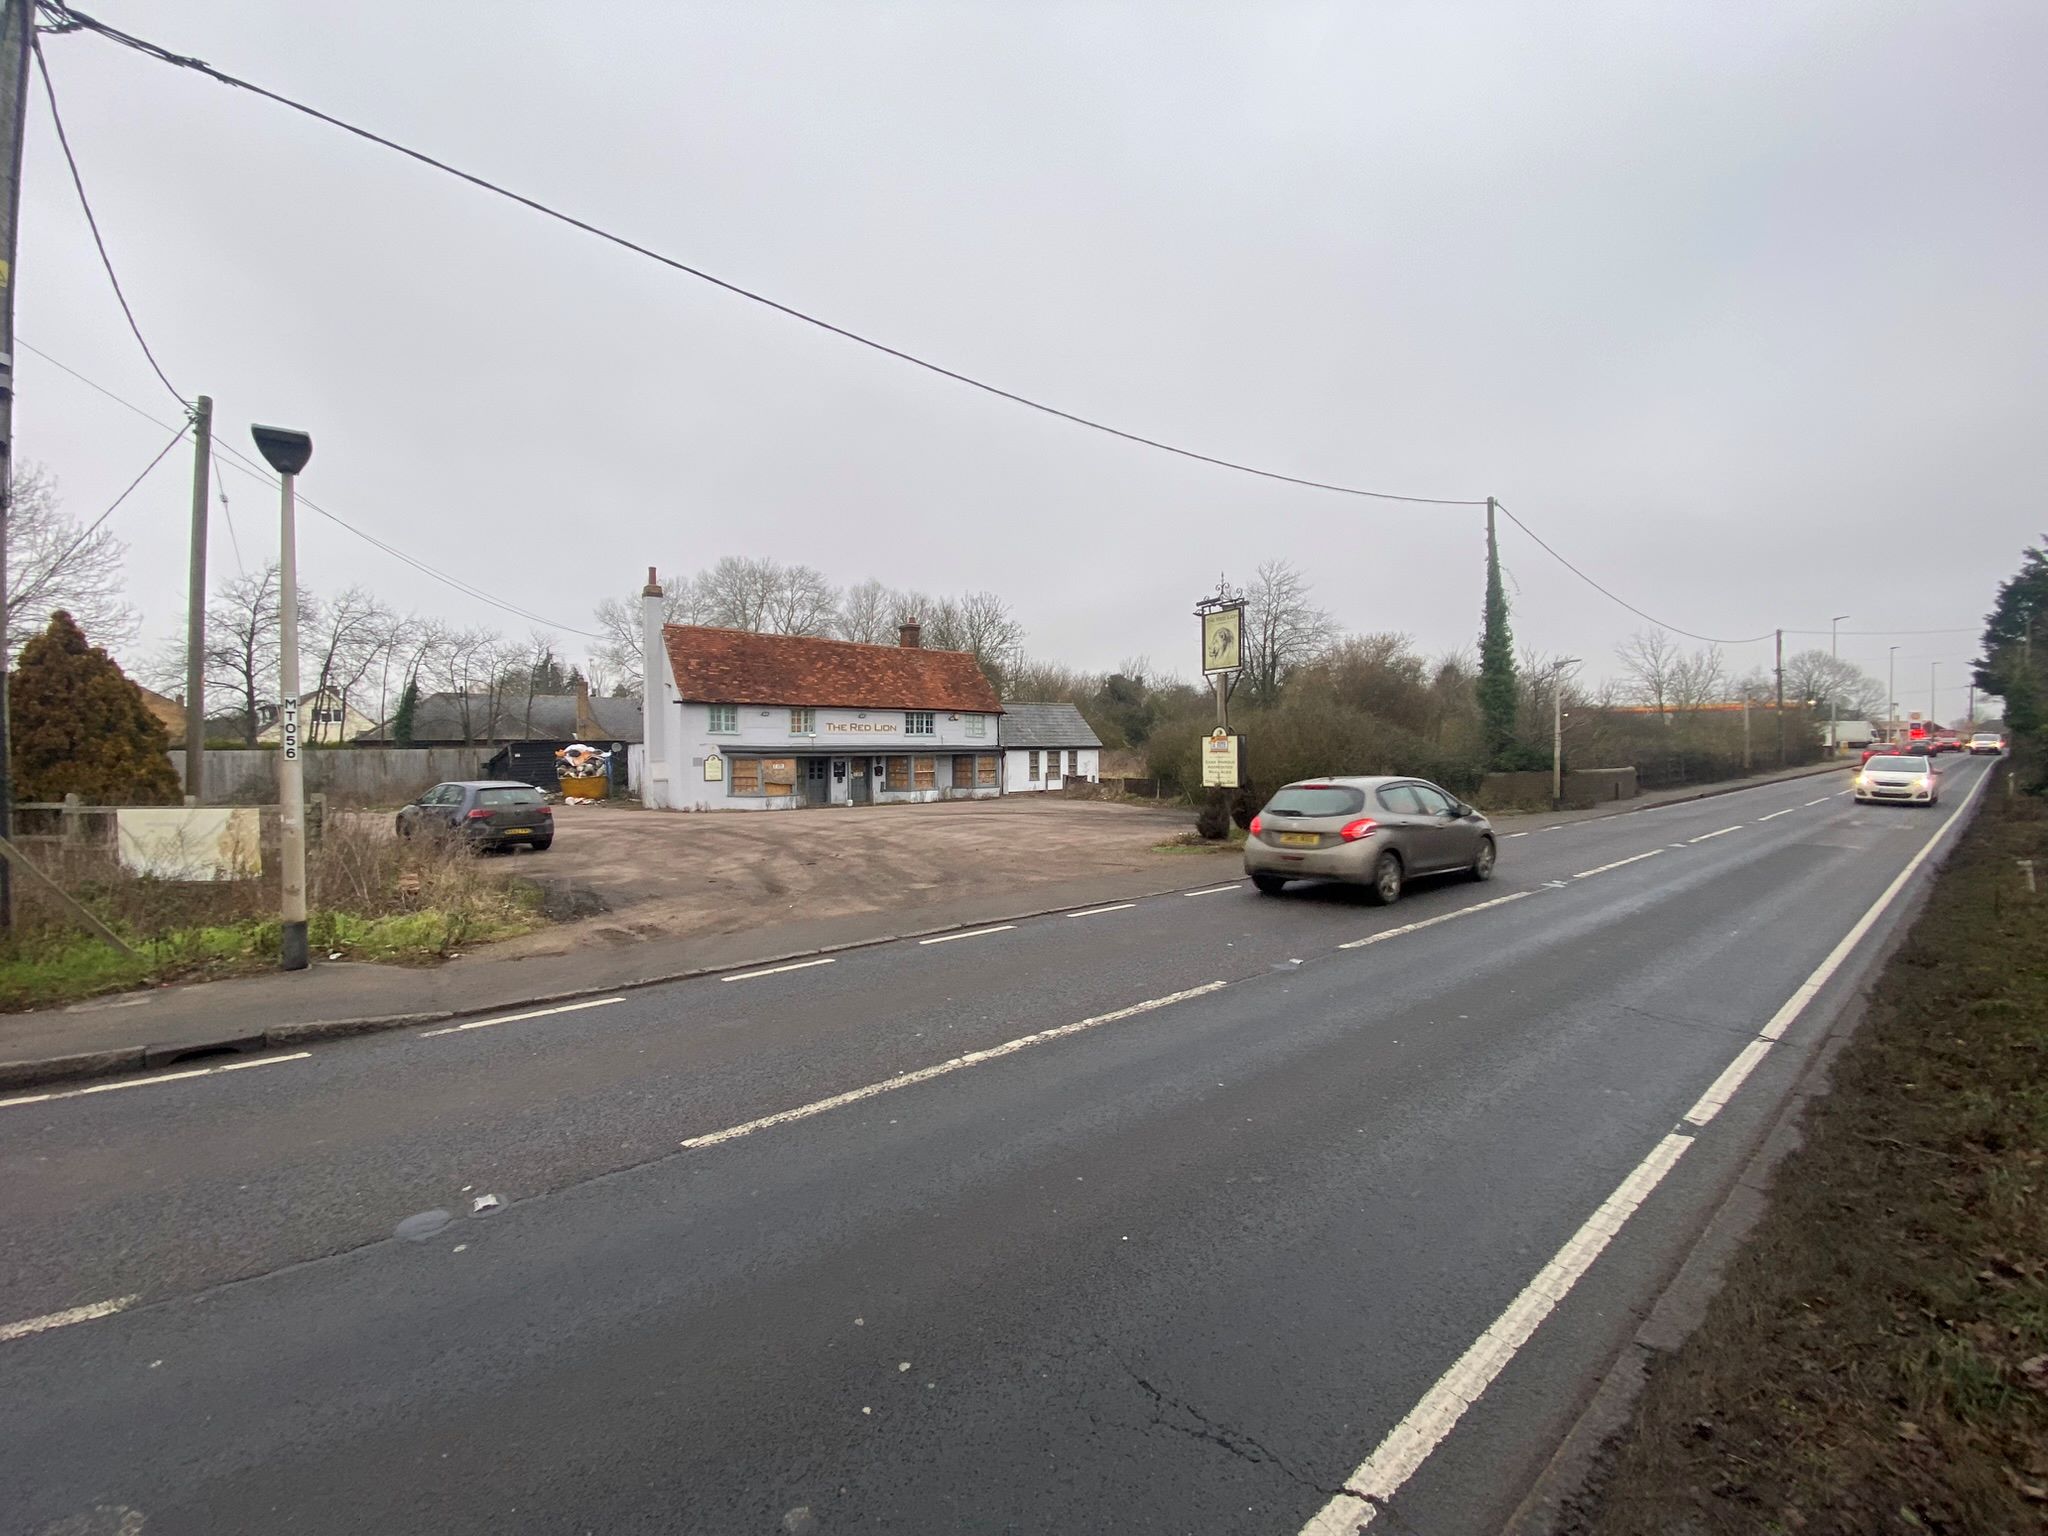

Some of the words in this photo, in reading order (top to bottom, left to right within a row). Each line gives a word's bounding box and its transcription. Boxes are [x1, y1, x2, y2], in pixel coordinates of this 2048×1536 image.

[826, 722, 847, 732] THE
[849, 722, 871, 732] RED
[874, 723, 897, 732] LION
